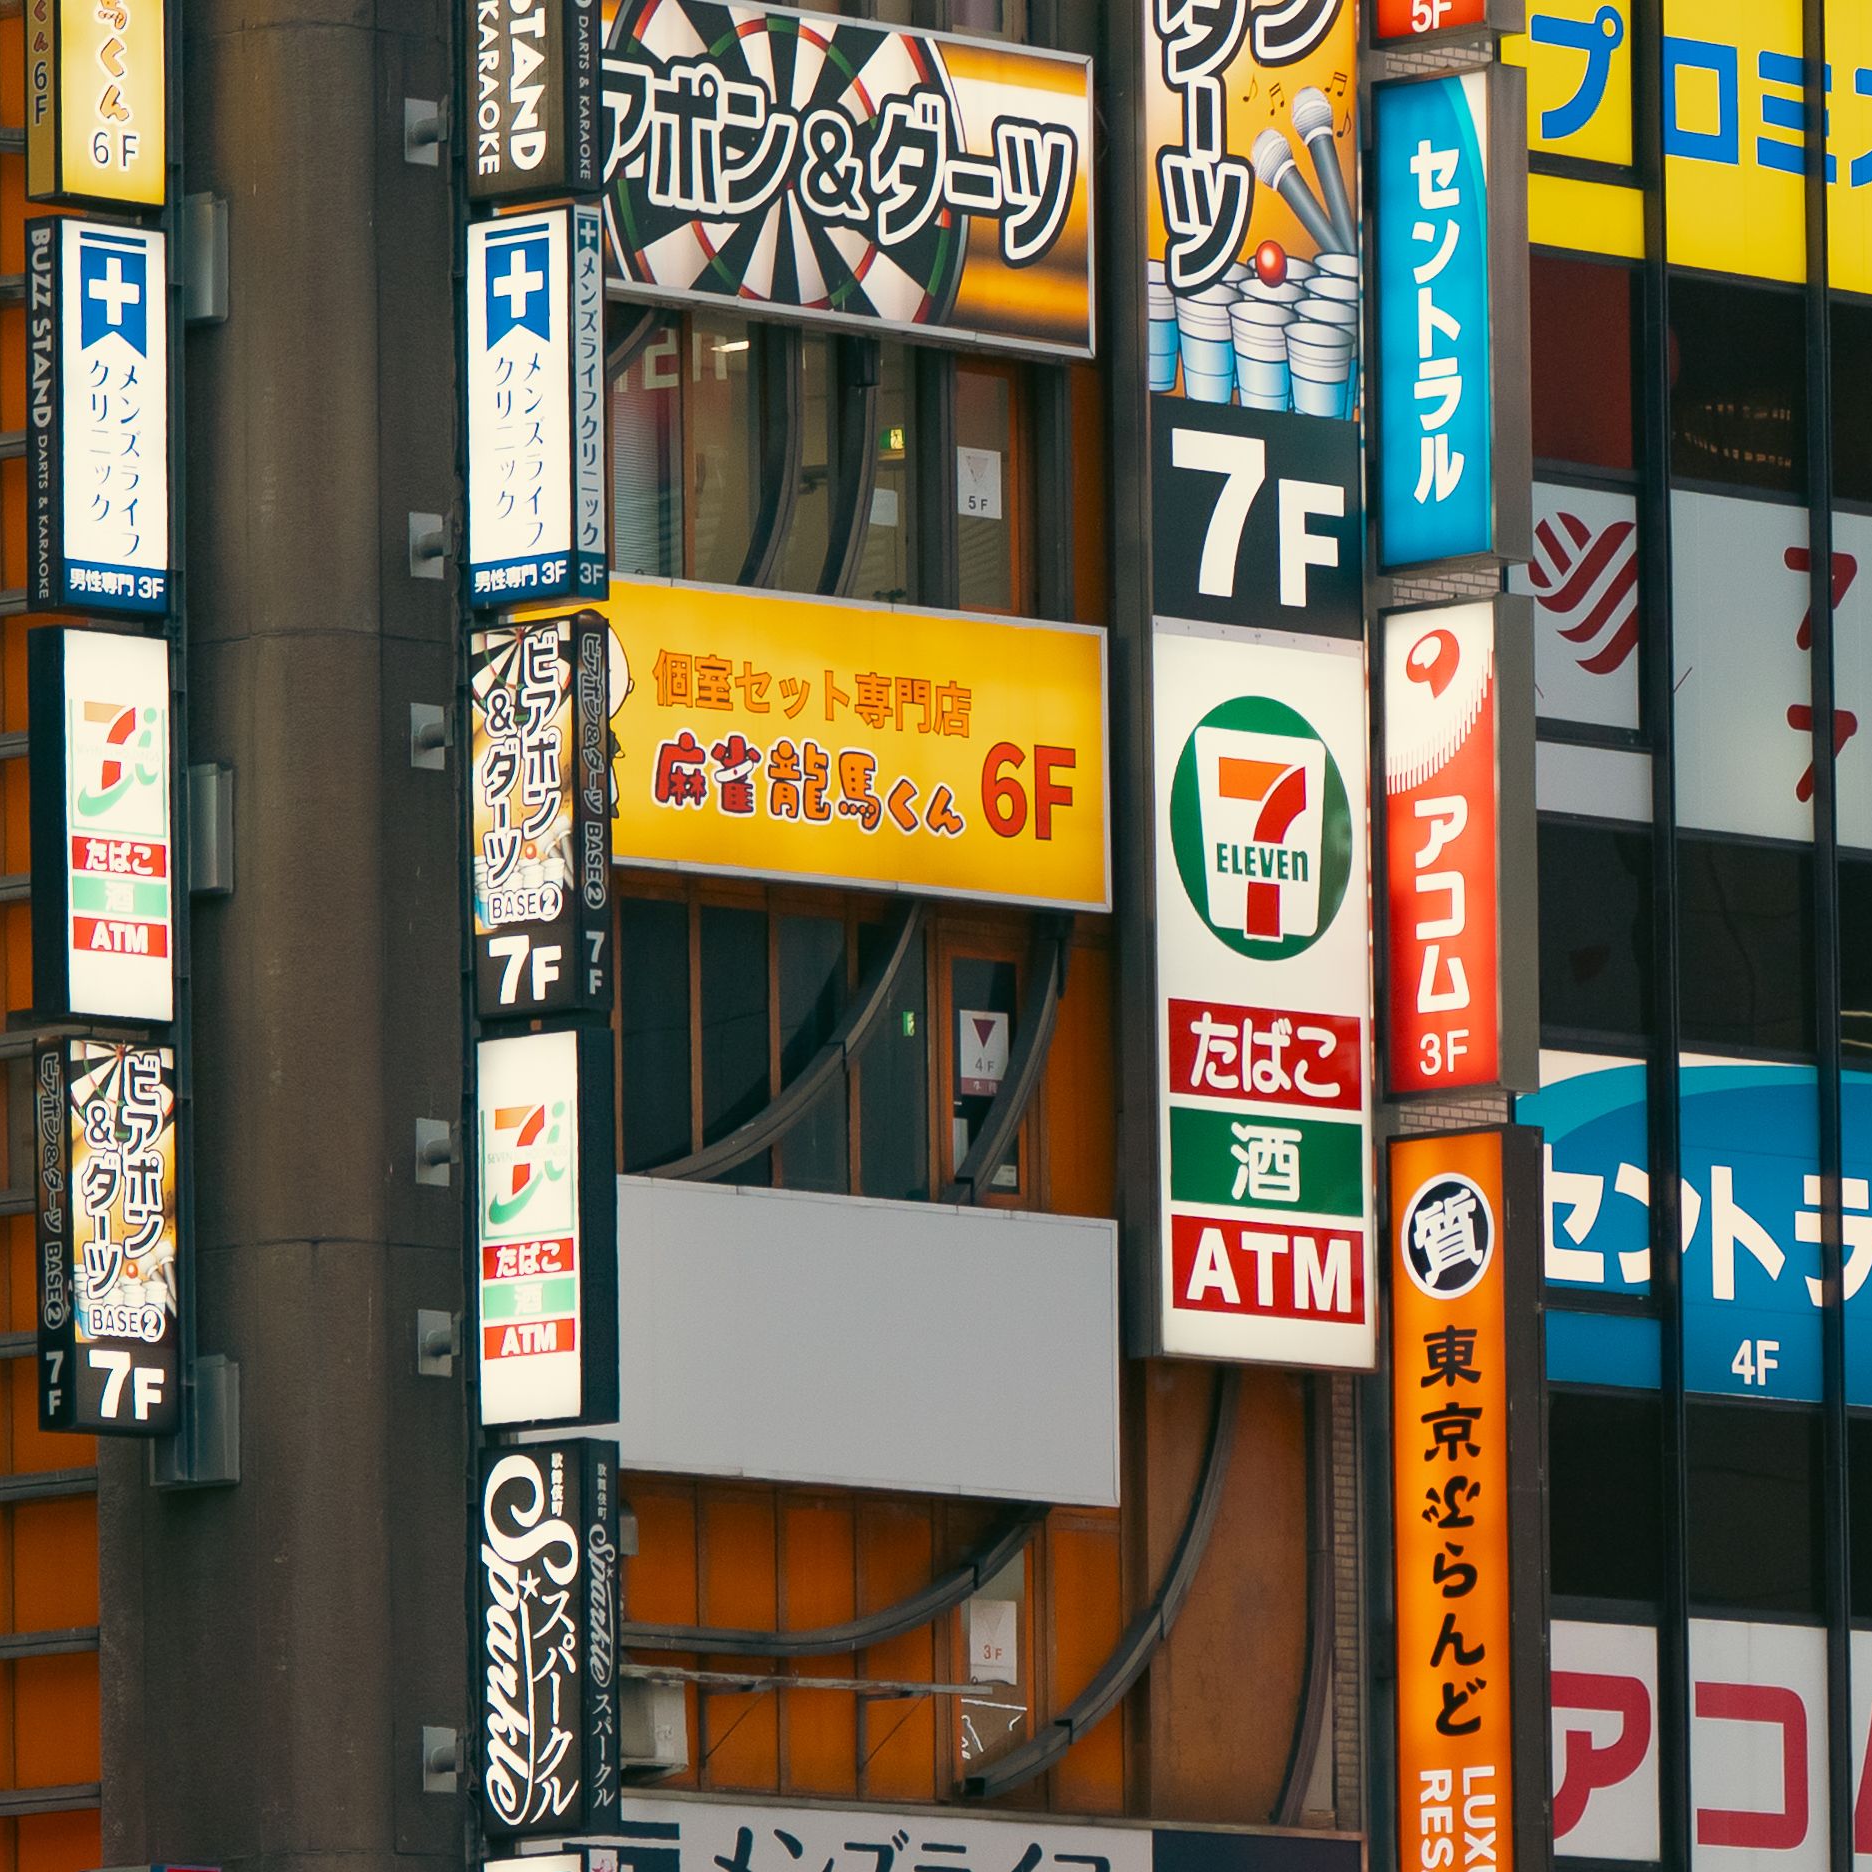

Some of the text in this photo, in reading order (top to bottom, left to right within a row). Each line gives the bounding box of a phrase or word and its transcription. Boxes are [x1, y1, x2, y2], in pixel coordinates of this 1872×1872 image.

[578, 15, 589, 70] DARTS
[478, 0, 500, 176] KARAOKE
[93, 132, 137, 167] 6F
[579, 95, 591, 180] KARAOKE
[31, 227, 52, 429] BUZZ STAND
[1410, 140, 1466, 504] セントラル
[87, 359, 112, 523] クリニック
[493, 355, 517, 521] クリニック
[578, 261, 599, 549] メンズライフクリニック
[38, 434, 50, 489] DARTS
[119, 364, 141, 559] メンズライフ
[523, 352, 544, 549] メンズライフ
[38, 514, 50, 599] KARAOKE
[1172, 428, 1345, 608] 7F
[69, 567, 164, 600] 男性専門 3F
[474, 558, 568, 595] 男性専門 3F
[578, 560, 603, 587] 3F
[524, 631, 561, 842] ビアポン
[652, 648, 972, 739] 個室セット専門店
[654, 730, 1077, 842] 麻雀龍馬くん 6F
[84, 838, 154, 876] たばこ
[1215, 842, 1310, 883] ELEVEN
[90, 921, 150, 955] ATM
[1415, 795, 1470, 1015] アコム
[488, 935, 562, 1005] 7F
[585, 931, 605, 996] 7F
[1190, 1011, 1342, 1099] たばこ
[1419, 1030, 1469, 1076] 3F
[123, 1054, 165, 1259] ビアポン
[1230, 1121, 1303, 1204] 酒
[495, 1241, 562, 1278] たばこ
[1186, 1228, 1353, 1315] ATM
[1413, 1188, 1484, 1289] 質
[500, 1322, 558, 1357] ATM
[1730, 1339, 1780, 1387] 4F
[88, 1349, 165, 1421] 7F
[1419, 1325, 1487, 1738] 東京ぶらんど
[530, 1590, 580, 1825] スパークル
[591, 1692, 616, 1810] スパークル
